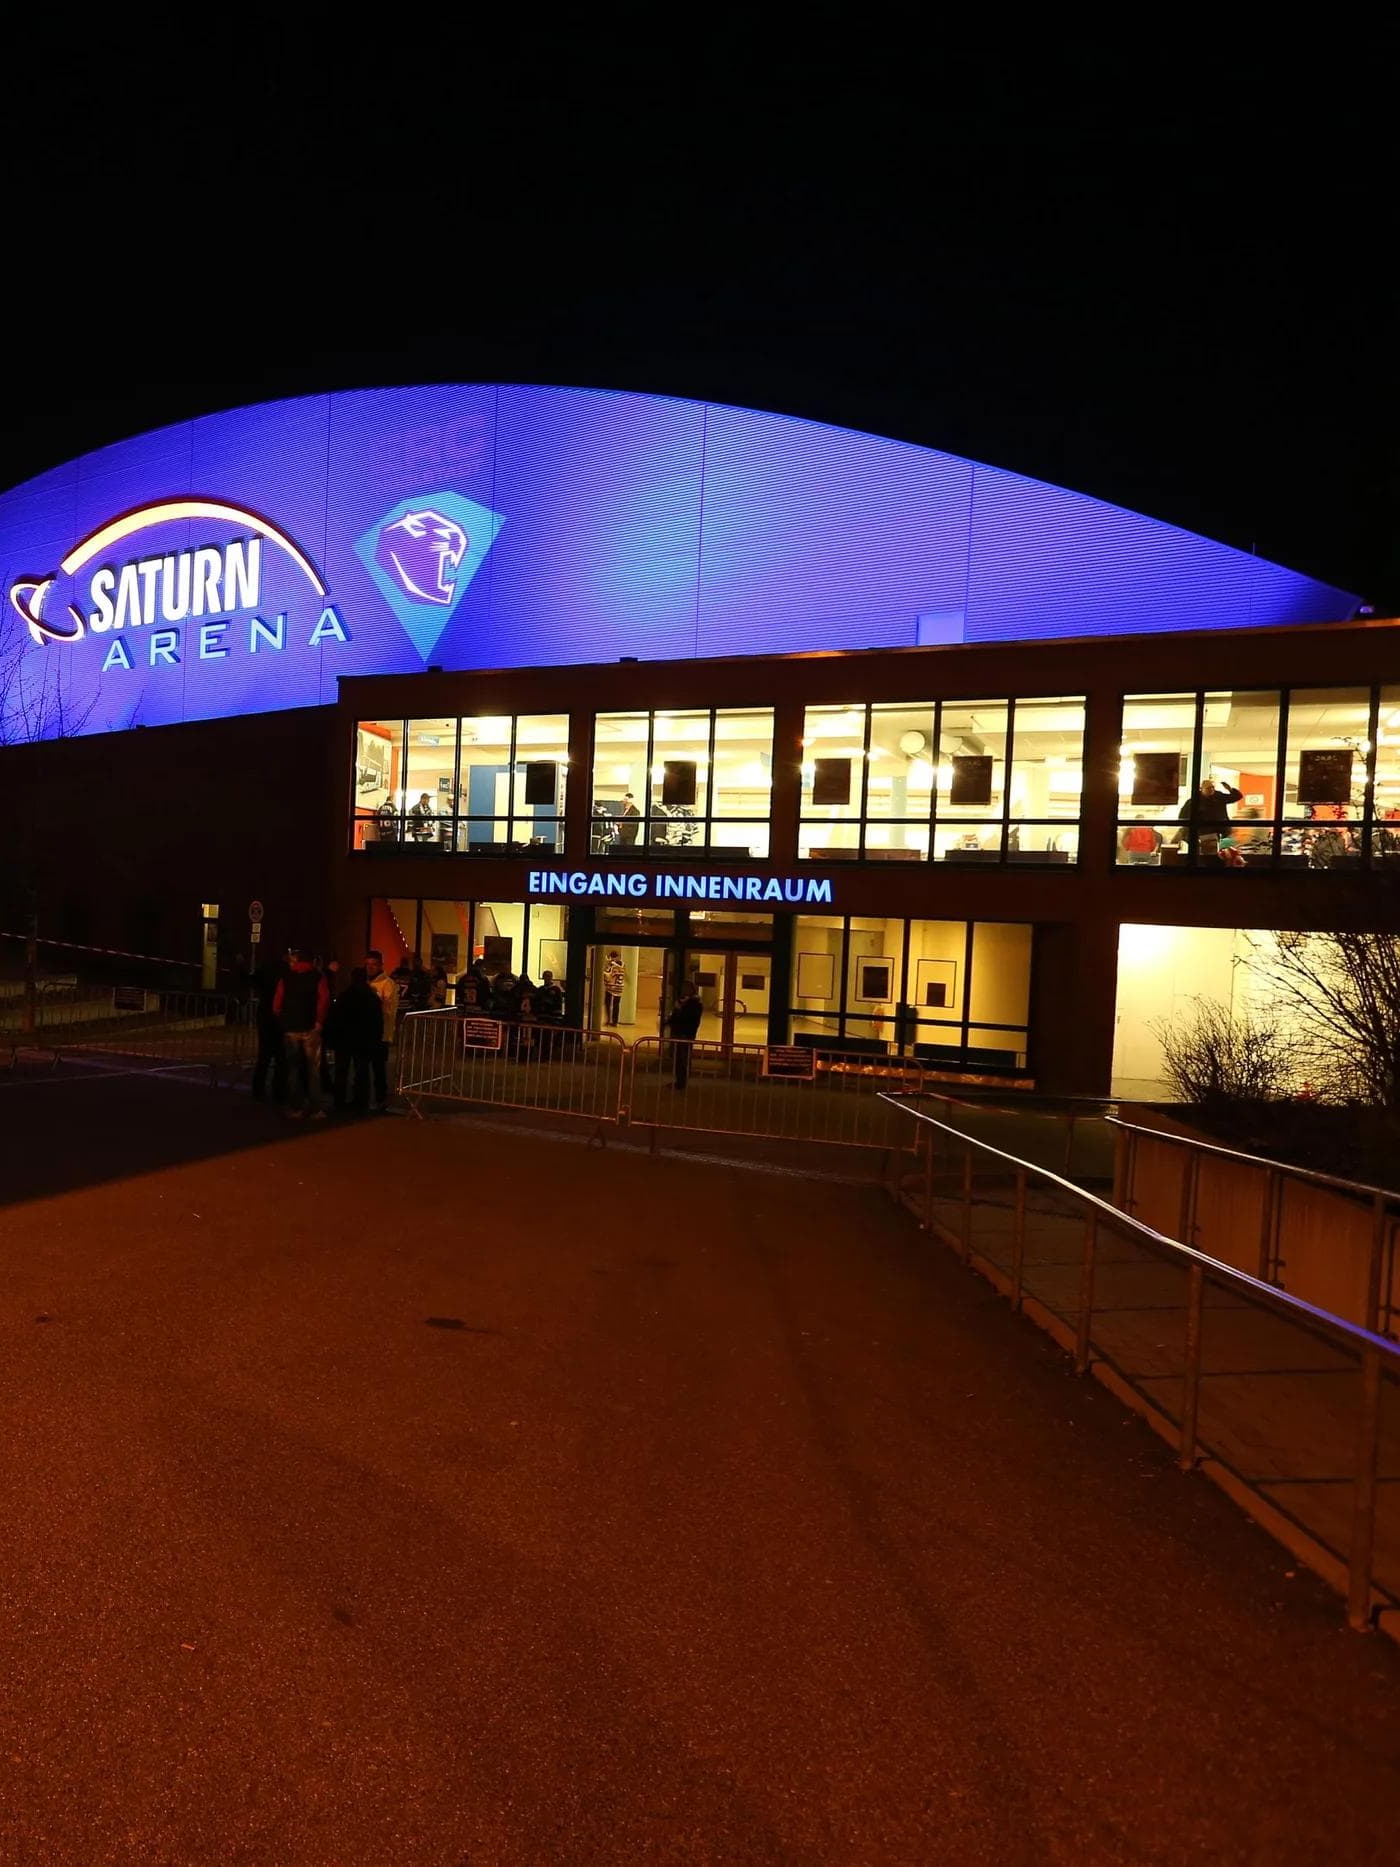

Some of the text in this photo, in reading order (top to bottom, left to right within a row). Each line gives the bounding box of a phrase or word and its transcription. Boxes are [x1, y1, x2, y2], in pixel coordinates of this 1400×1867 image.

[88, 536, 262, 634] SATURN
[100, 606, 352, 672] ARENA
[529, 871, 832, 903] EINGANG INNENRAUM
